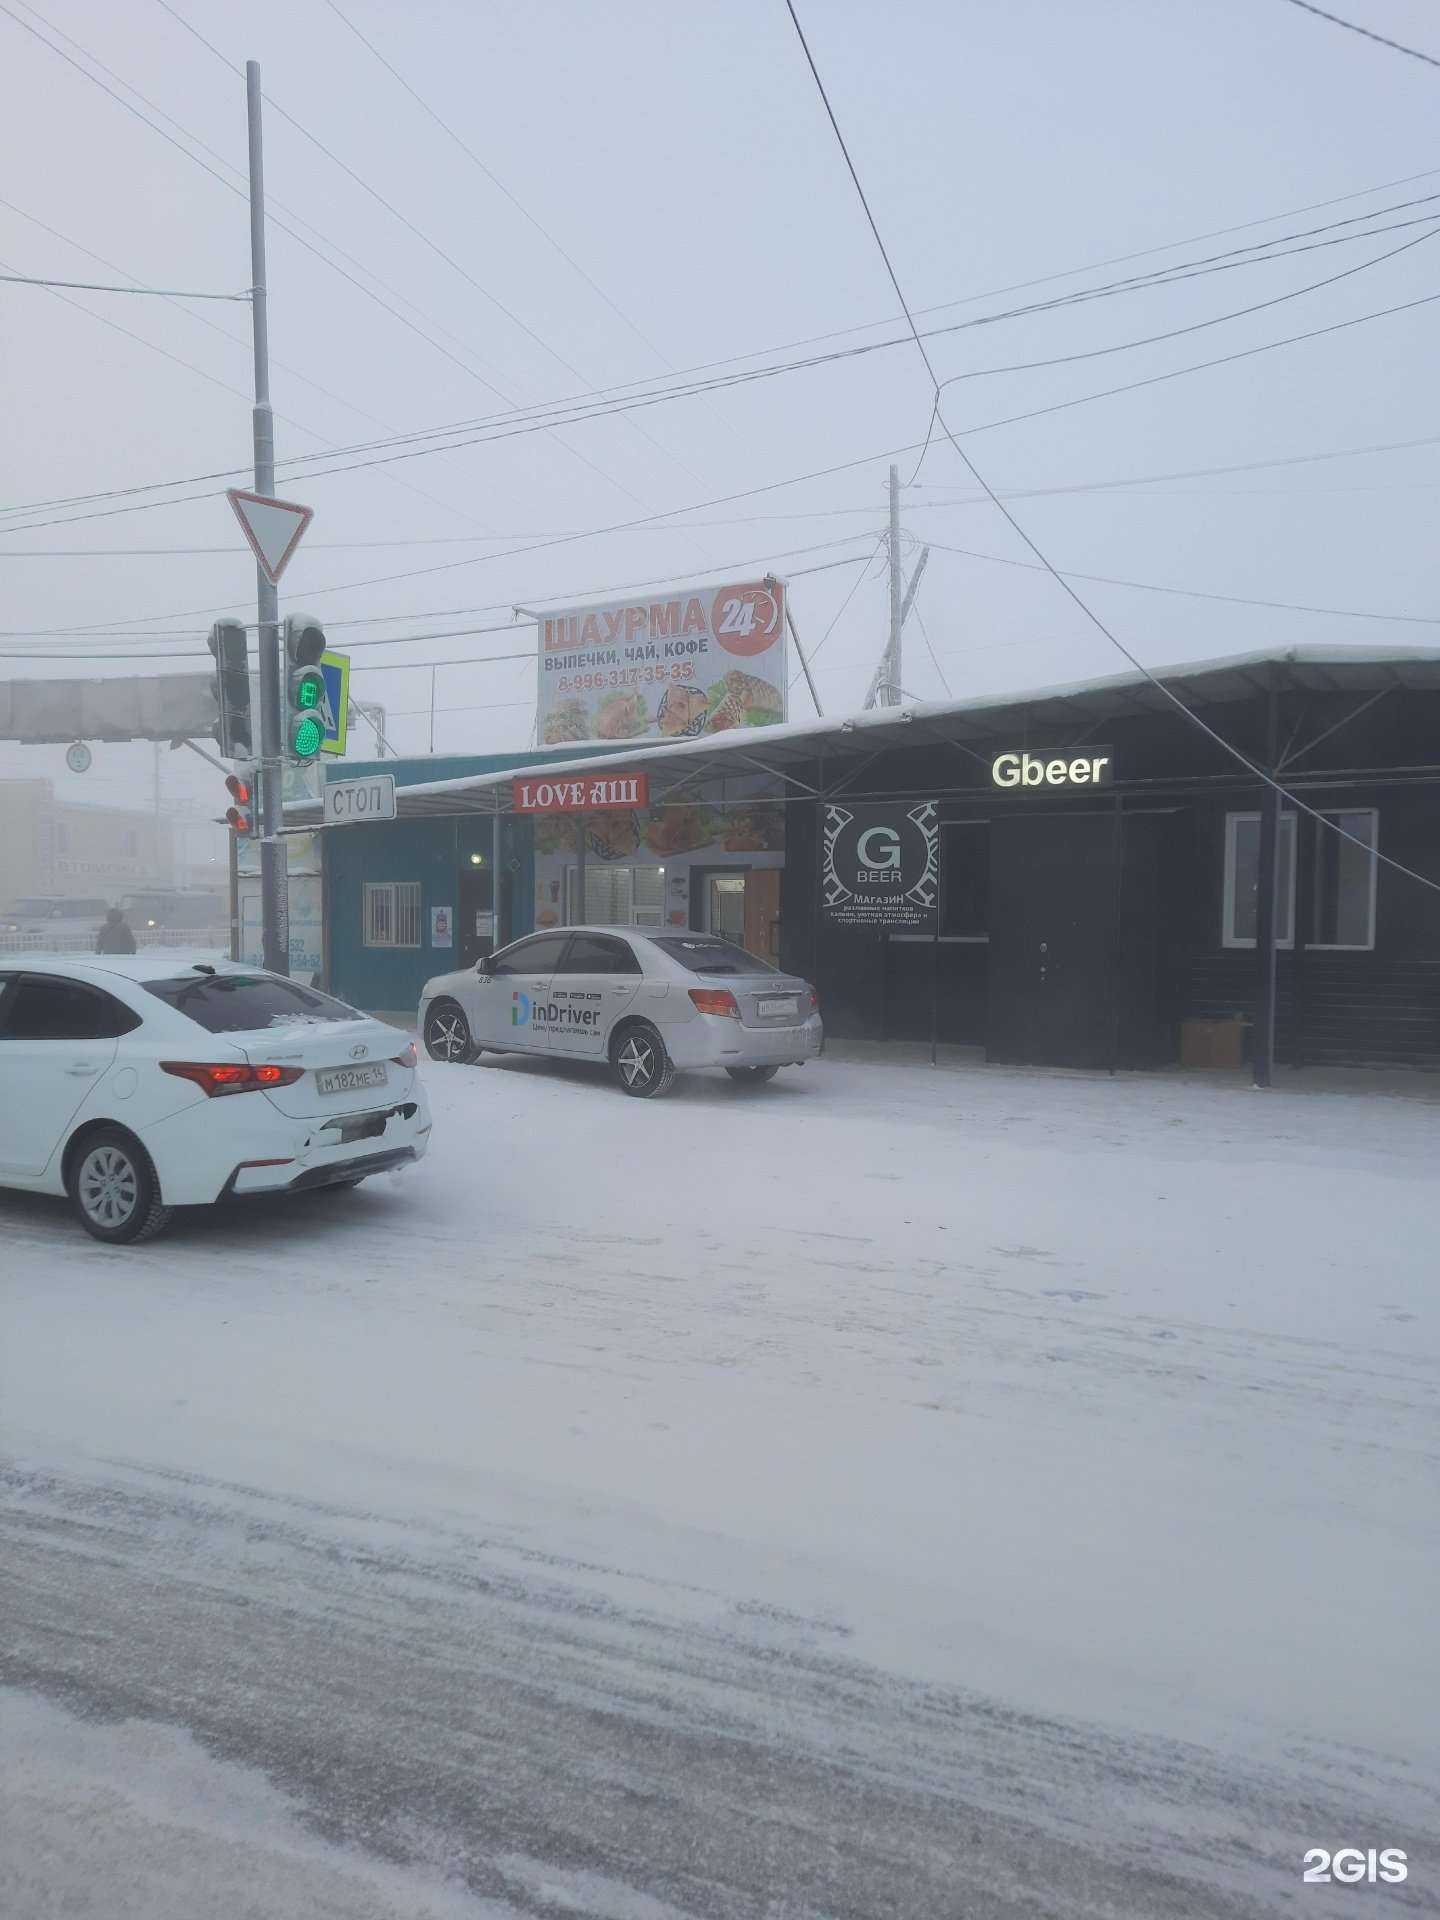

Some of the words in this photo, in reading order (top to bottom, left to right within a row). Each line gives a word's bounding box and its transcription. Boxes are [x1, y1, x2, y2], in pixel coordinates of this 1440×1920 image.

[544, 598, 707, 651] ШАУРМА
[719, 599, 757, 636] 24
[544, 650, 620, 672] ВЫПЕЧКИ,
[624, 643, 659, 662] ЧАЙ,
[664, 638, 709, 658] КОФЕ
[992, 753, 1109, 787] Gbeer
[333, 786, 382, 815] СТОП
[521, 782, 585, 808] LOVE
[857, 827, 901, 870] G
[857, 871, 903, 883] BEER
[532, 1001, 600, 1026] inDriver
